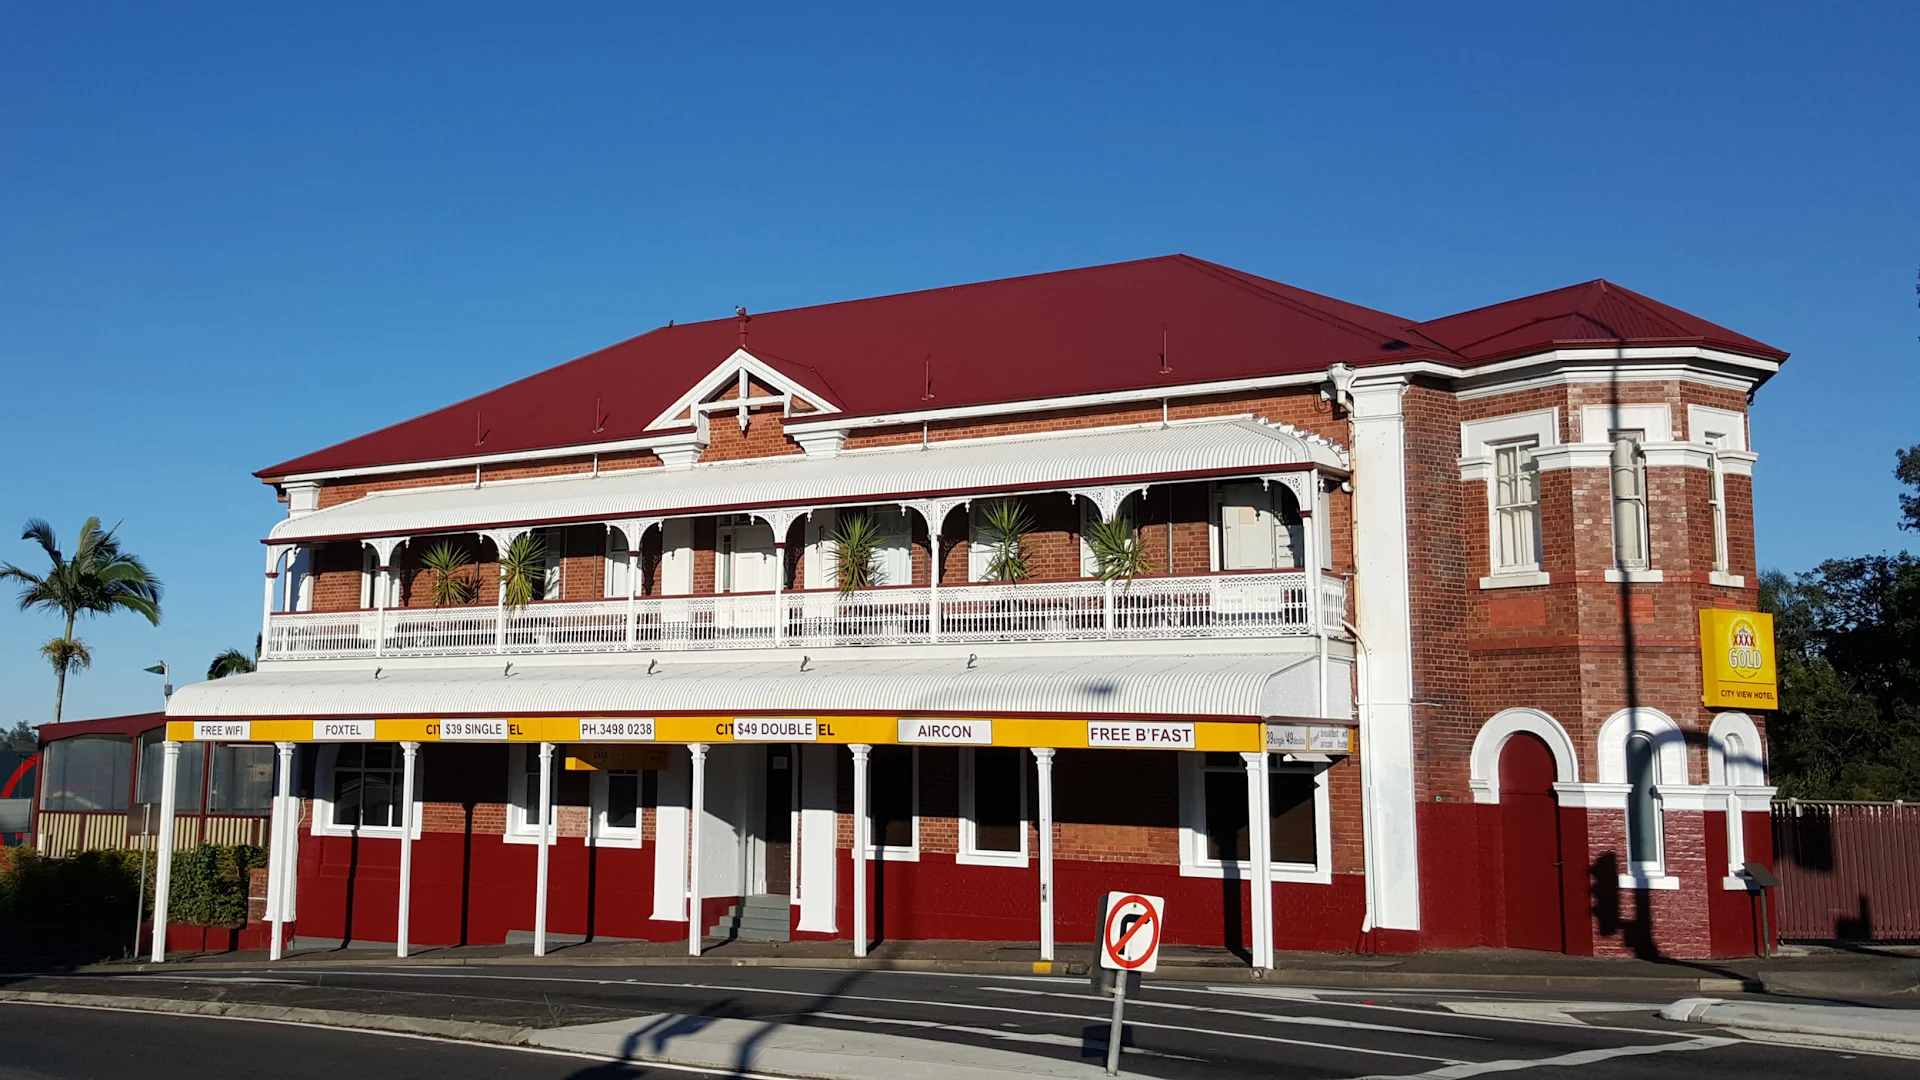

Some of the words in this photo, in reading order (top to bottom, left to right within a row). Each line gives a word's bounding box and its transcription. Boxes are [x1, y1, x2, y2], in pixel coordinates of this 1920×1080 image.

[1733, 634, 1755, 647] XXXX
[1728, 648, 1762, 669] GOLD
[1720, 690, 1734, 698] CITY
[1736, 690, 1752, 698] VIEW
[1754, 692, 1774, 700] HOTEL
[200, 725, 224, 736] FREE
[225, 725, 243, 736] WIFI
[325, 724, 362, 736] FOXTEL
[445, 724, 462, 735] $39
[465, 724, 502, 735] SINGLE
[508, 724, 523, 735] EL
[582, 724, 624, 735] PH.3498
[627, 724, 652, 735] 0238
[738, 722, 758, 736] $49
[761, 723, 812, 736] DOUBLE
[817, 724, 834, 736] EL
[918, 725, 972, 738] AIRCON
[1090, 728, 1130, 741] FREE
